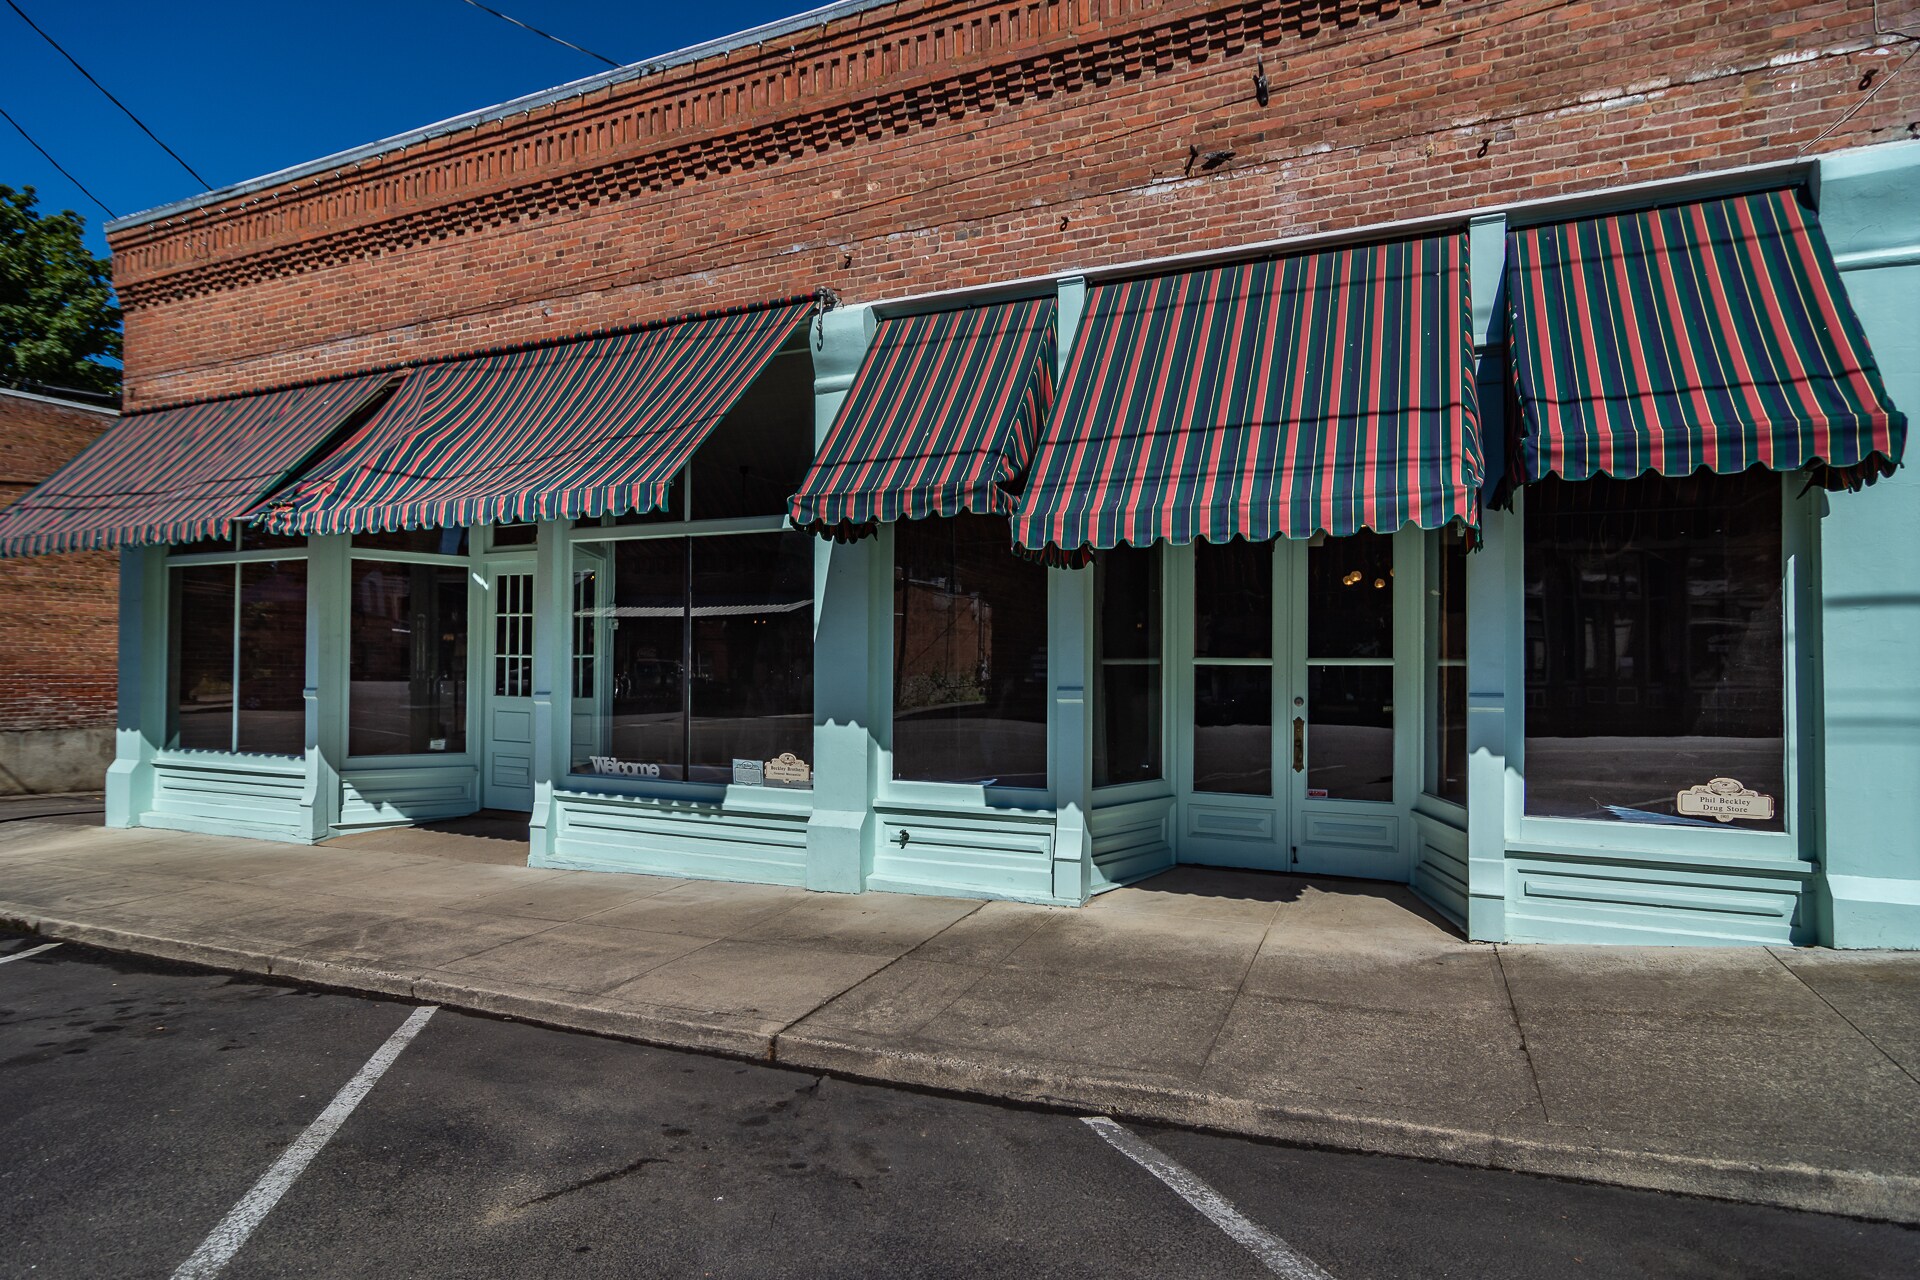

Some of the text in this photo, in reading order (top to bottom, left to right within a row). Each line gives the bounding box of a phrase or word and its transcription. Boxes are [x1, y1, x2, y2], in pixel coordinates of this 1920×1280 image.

[589, 756, 660, 777] Welcome
[1719, 797, 1751, 806] Beckley
[1726, 805, 1748, 813] Store
